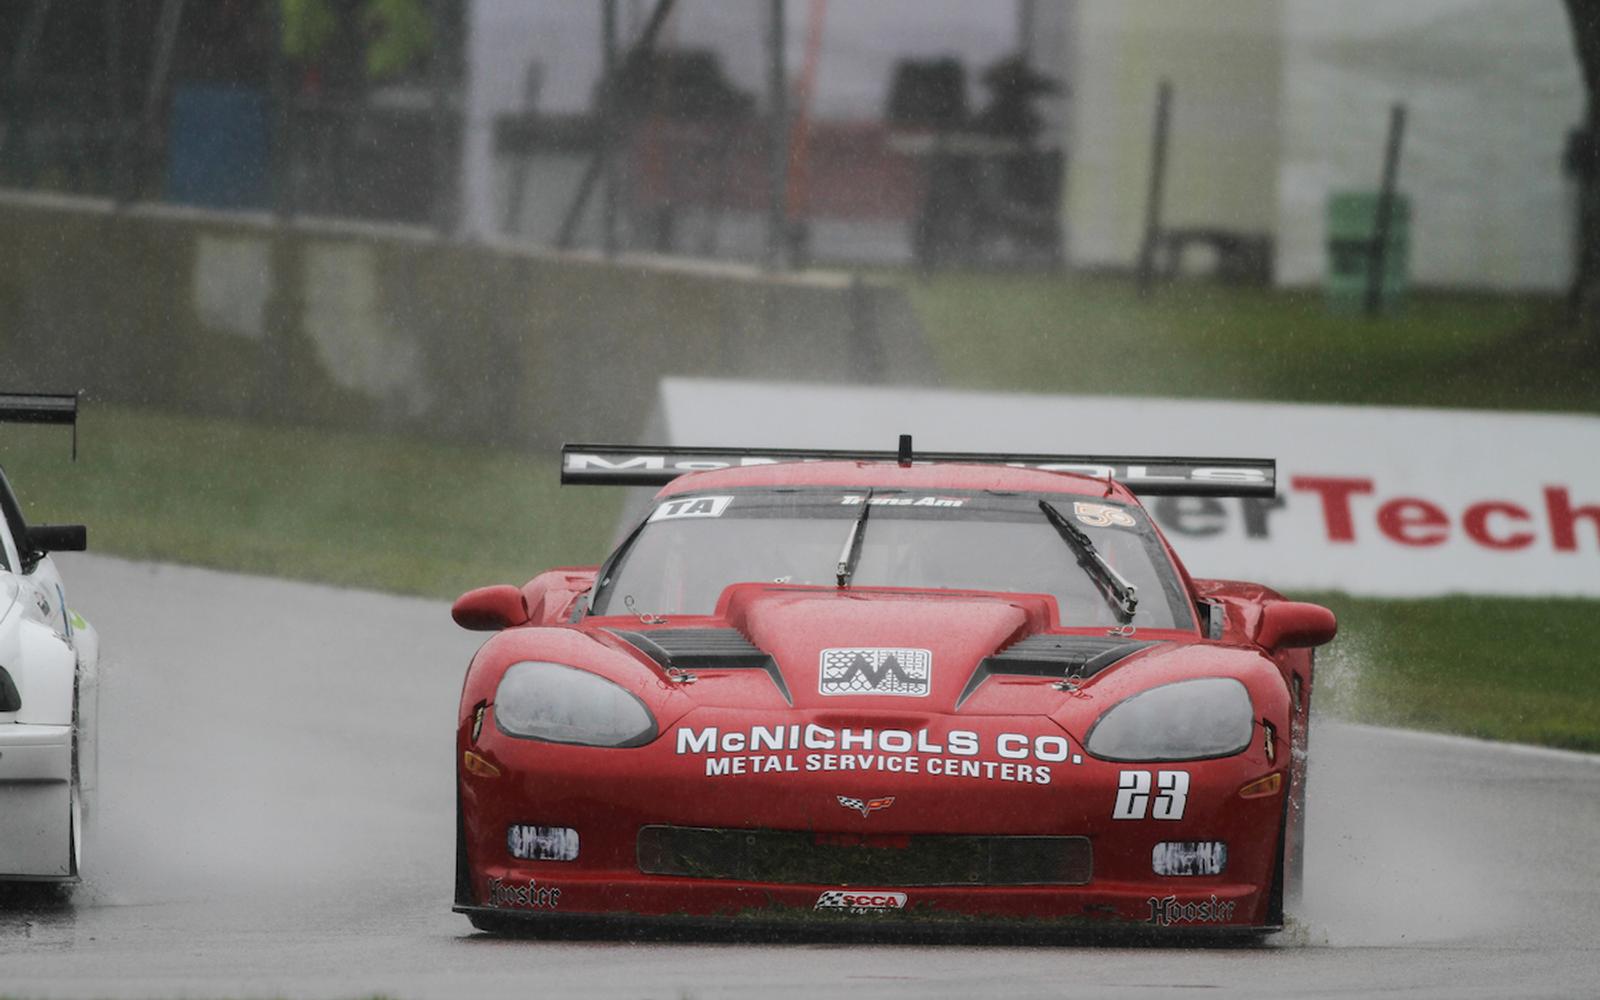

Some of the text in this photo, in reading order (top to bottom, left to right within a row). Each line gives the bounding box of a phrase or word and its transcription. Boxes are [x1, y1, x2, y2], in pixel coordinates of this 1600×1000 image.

[665, 498, 716, 516] TA
[676, 723, 1083, 764] McNICHOLS CO.
[705, 753, 1052, 785] METAL SERVICE CENTERS
[1112, 770, 1190, 820] 23
[842, 895, 899, 907] SCCA
[1147, 895, 1236, 926] Hoosier
